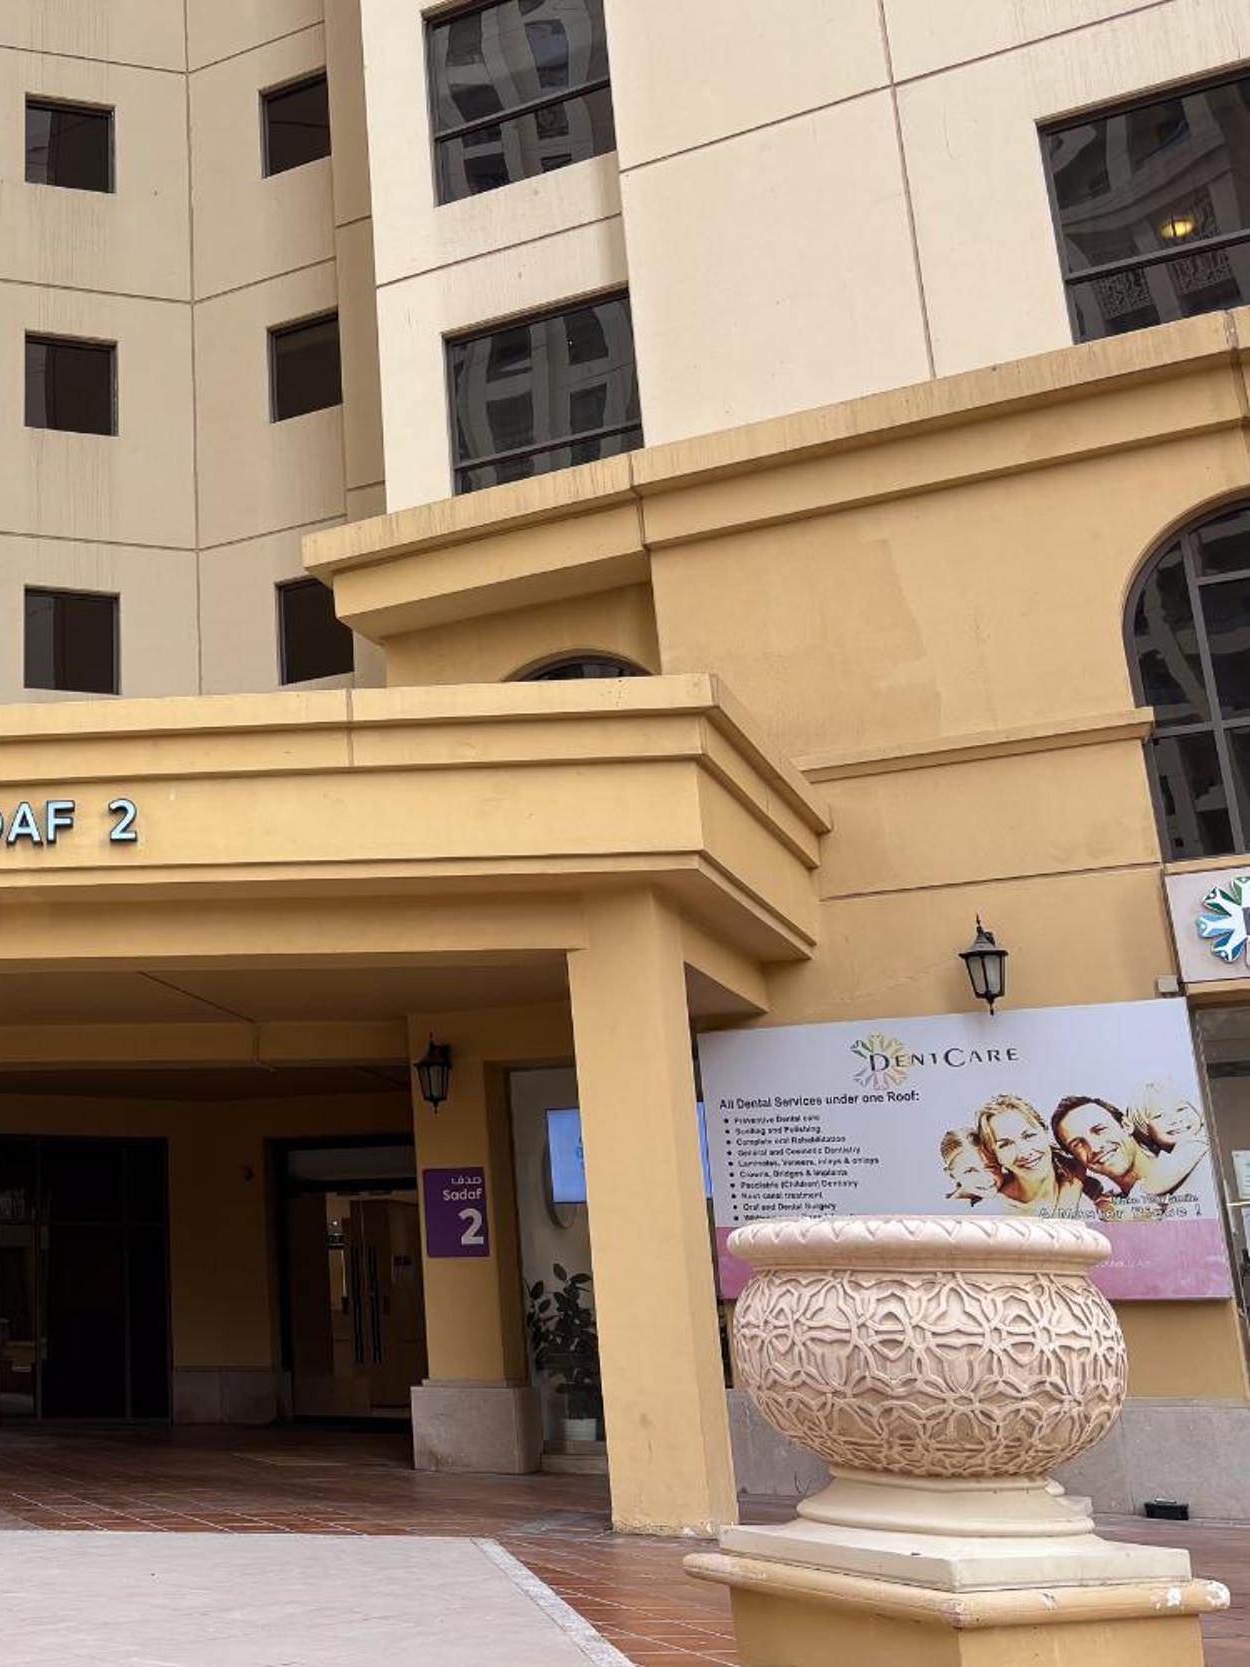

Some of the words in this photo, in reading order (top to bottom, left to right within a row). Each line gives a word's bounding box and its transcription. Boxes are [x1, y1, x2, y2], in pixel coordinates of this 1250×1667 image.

[107, 798, 138, 843] 2
[719, 1098, 734, 1110] All
[736, 1098, 771, 1110] Dental
[774, 1096, 823, 1108] Services
[826, 1094, 858, 1105] under
[862, 1094, 884, 1104] one
[887, 1090, 920, 1102] Roof:
[769, 1148, 784, 1156] and
[442, 1188, 483, 1201] Sadaf
[761, 1202, 776, 1211] and
[458, 1208, 485, 1246] 2
